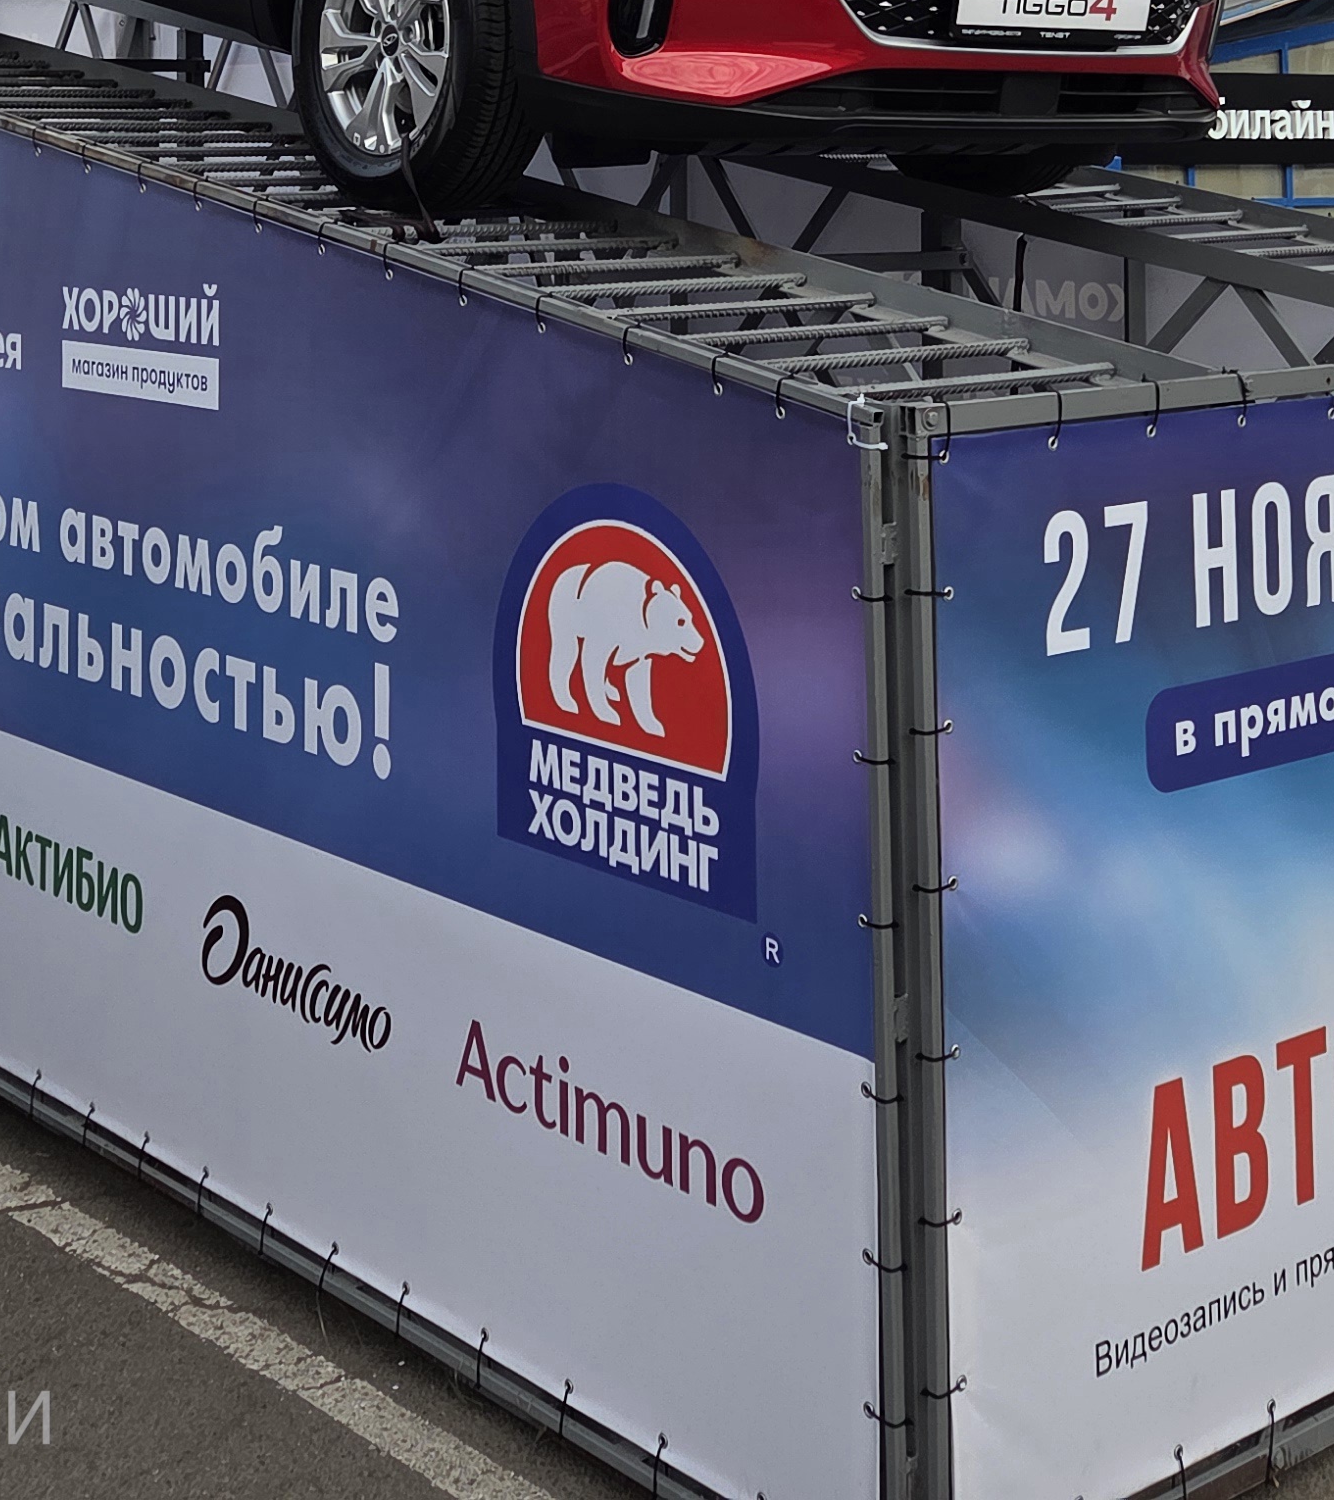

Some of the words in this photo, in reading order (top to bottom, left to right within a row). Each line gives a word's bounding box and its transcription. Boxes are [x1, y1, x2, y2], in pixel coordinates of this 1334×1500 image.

[62, 283, 220, 347] ХОРОШИЙ
[72, 358, 128, 382] магазин
[132, 363, 209, 393] продуктов
[60, 507, 401, 643] автомобиле
[1042, 501, 1149, 657] 27
[1174, 703, 1196, 756] в
[529, 739, 720, 837] МЕДВЕДЬ
[528, 789, 719, 892] ХОЛДИНГ
[455, 1019, 765, 1224] Actimuno
[1094, 1281, 1265, 1378] Видеозапись
[1273, 1268, 1287, 1298] и
